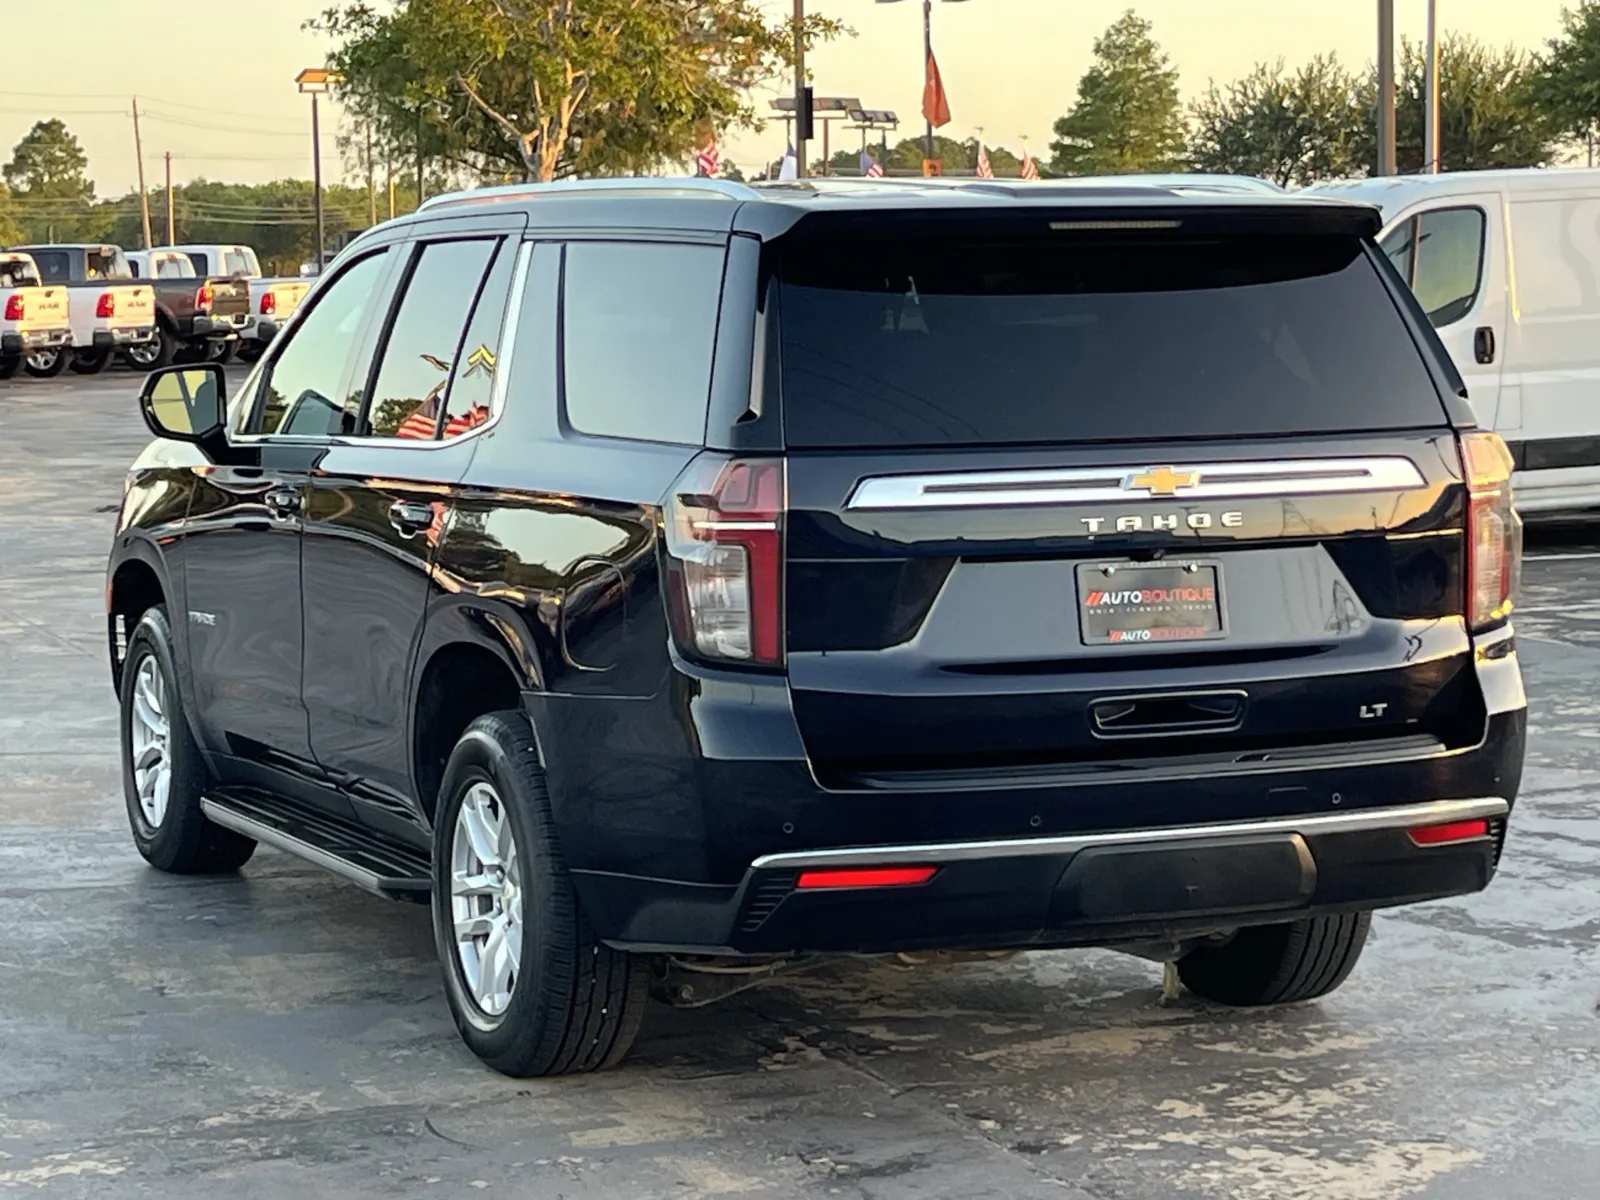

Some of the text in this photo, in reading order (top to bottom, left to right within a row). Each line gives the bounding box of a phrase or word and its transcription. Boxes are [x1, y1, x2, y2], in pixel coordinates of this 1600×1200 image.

[1080, 511, 1244, 535] TAHOE
[1100, 587, 1214, 606] AUTOBOUTIQUE
[1359, 702, 1388, 718] LT
